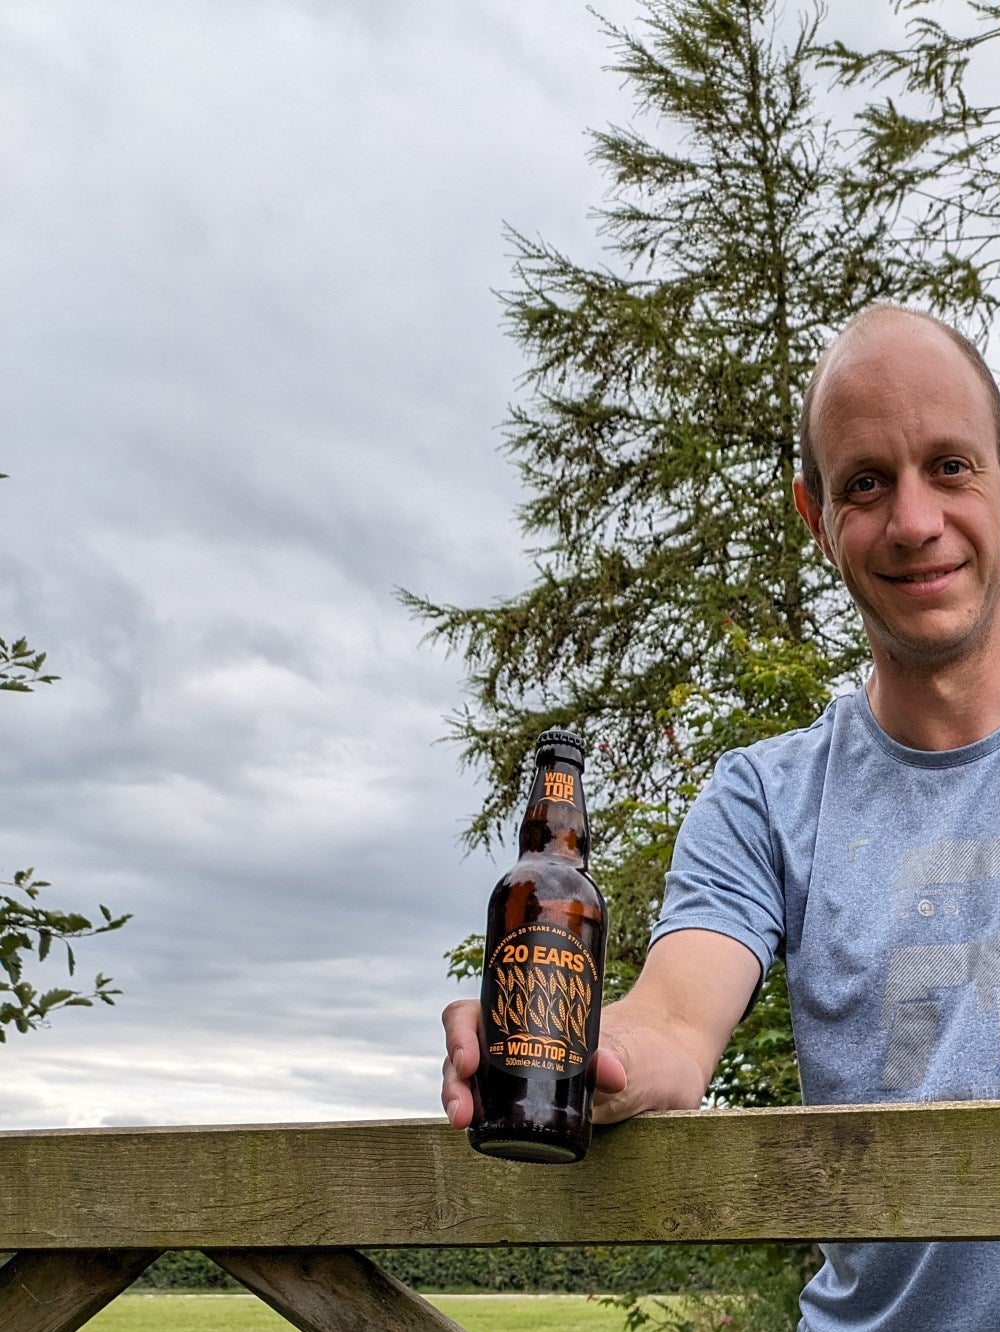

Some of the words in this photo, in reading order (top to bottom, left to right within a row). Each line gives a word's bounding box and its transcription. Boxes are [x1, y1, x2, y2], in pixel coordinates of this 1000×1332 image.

[545, 772, 574, 786] WOLD
[502, 944, 529, 963] 20
[533, 945, 585, 973] EARS
[551, 928, 567, 936] AND
[567, 934, 583, 950] STILL
[582, 949, 598, 981] GROWING
[489, 1045, 504, 1053] 2003
[507, 1041, 543, 1058] WOLD
[568, 1053, 583, 1063] 2023
